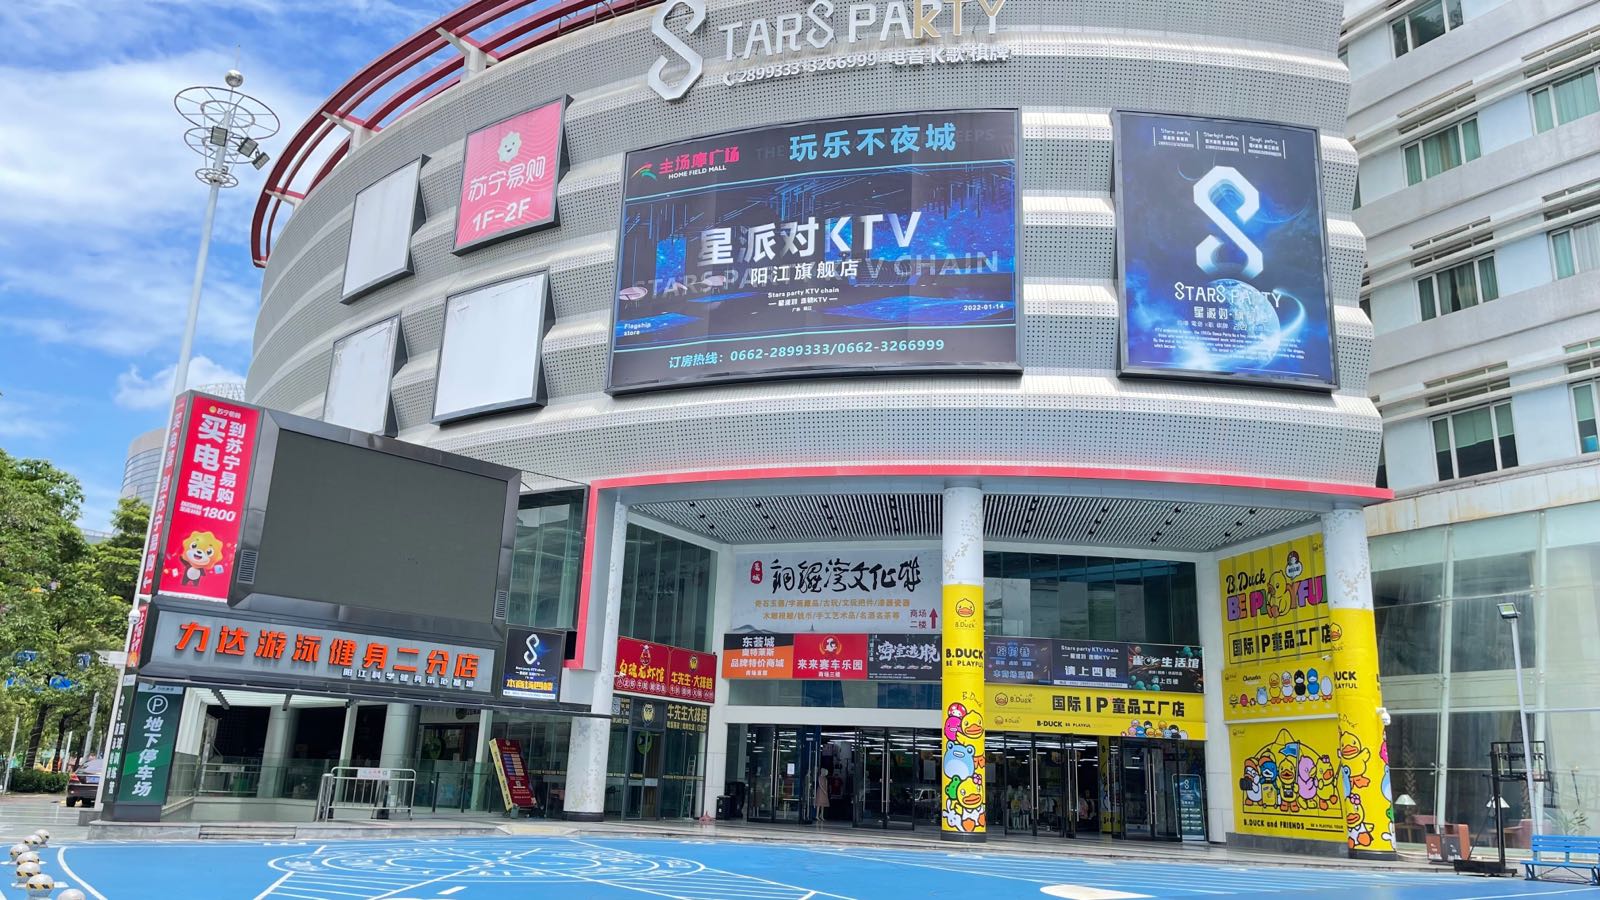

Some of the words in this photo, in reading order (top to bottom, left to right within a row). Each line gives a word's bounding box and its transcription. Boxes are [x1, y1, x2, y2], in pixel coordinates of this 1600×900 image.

[889, 48, 926, 65] 电音
[931, 46, 965, 64] K歌
[966, 44, 1009, 61] 棋牌
[739, 62, 800, 83] 2899333
[808, 53, 877, 73] 3266999
[789, 122, 956, 162] 玩乐不夜城
[468, 156, 546, 202] 苏宁易购
[668, 170, 688, 180] HOME
[688, 167, 708, 176] FIELD
[708, 165, 727, 173] MALL
[472, 197, 532, 232] 1F-2F
[750, 259, 860, 285] 阳江旗舰店
[893, 250, 998, 278] CHAIN
[786, 290, 805, 298] party
[1174, 281, 1226, 304] STARS
[1231, 288, 1282, 308] PATY
[962, 303, 1004, 311] 2022-01-14
[624, 322, 651, 330] Flagship
[730, 339, 945, 361] 0662-2899333/0662-3266999
[187, 413, 228, 502] 买电器
[215, 420, 246, 505] 到苏宁易购
[202, 506, 237, 522] 1800
[1226, 568, 1266, 595] B.Duck
[909, 608, 927, 618] 商场
[1227, 593, 1248, 622] BE
[909, 620, 927, 629] 二楼
[175, 621, 480, 678] 力达游泳健身二分店
[877, 640, 940, 663] 密室逃脱
[946, 648, 984, 660] B.DUCK
[730, 658, 785, 668] 品牌特价商城
[797, 658, 863, 671] 来来赛车乐园
[1064, 665, 1118, 678] 请上四楼
[1161, 657, 1200, 669] 生活馆
[131, 715, 165, 798] 地下停车场
[1243, 818, 1265, 827] B.DUCK
[1266, 820, 1278, 828] and
[1279, 820, 1305, 830] FRIENDS
